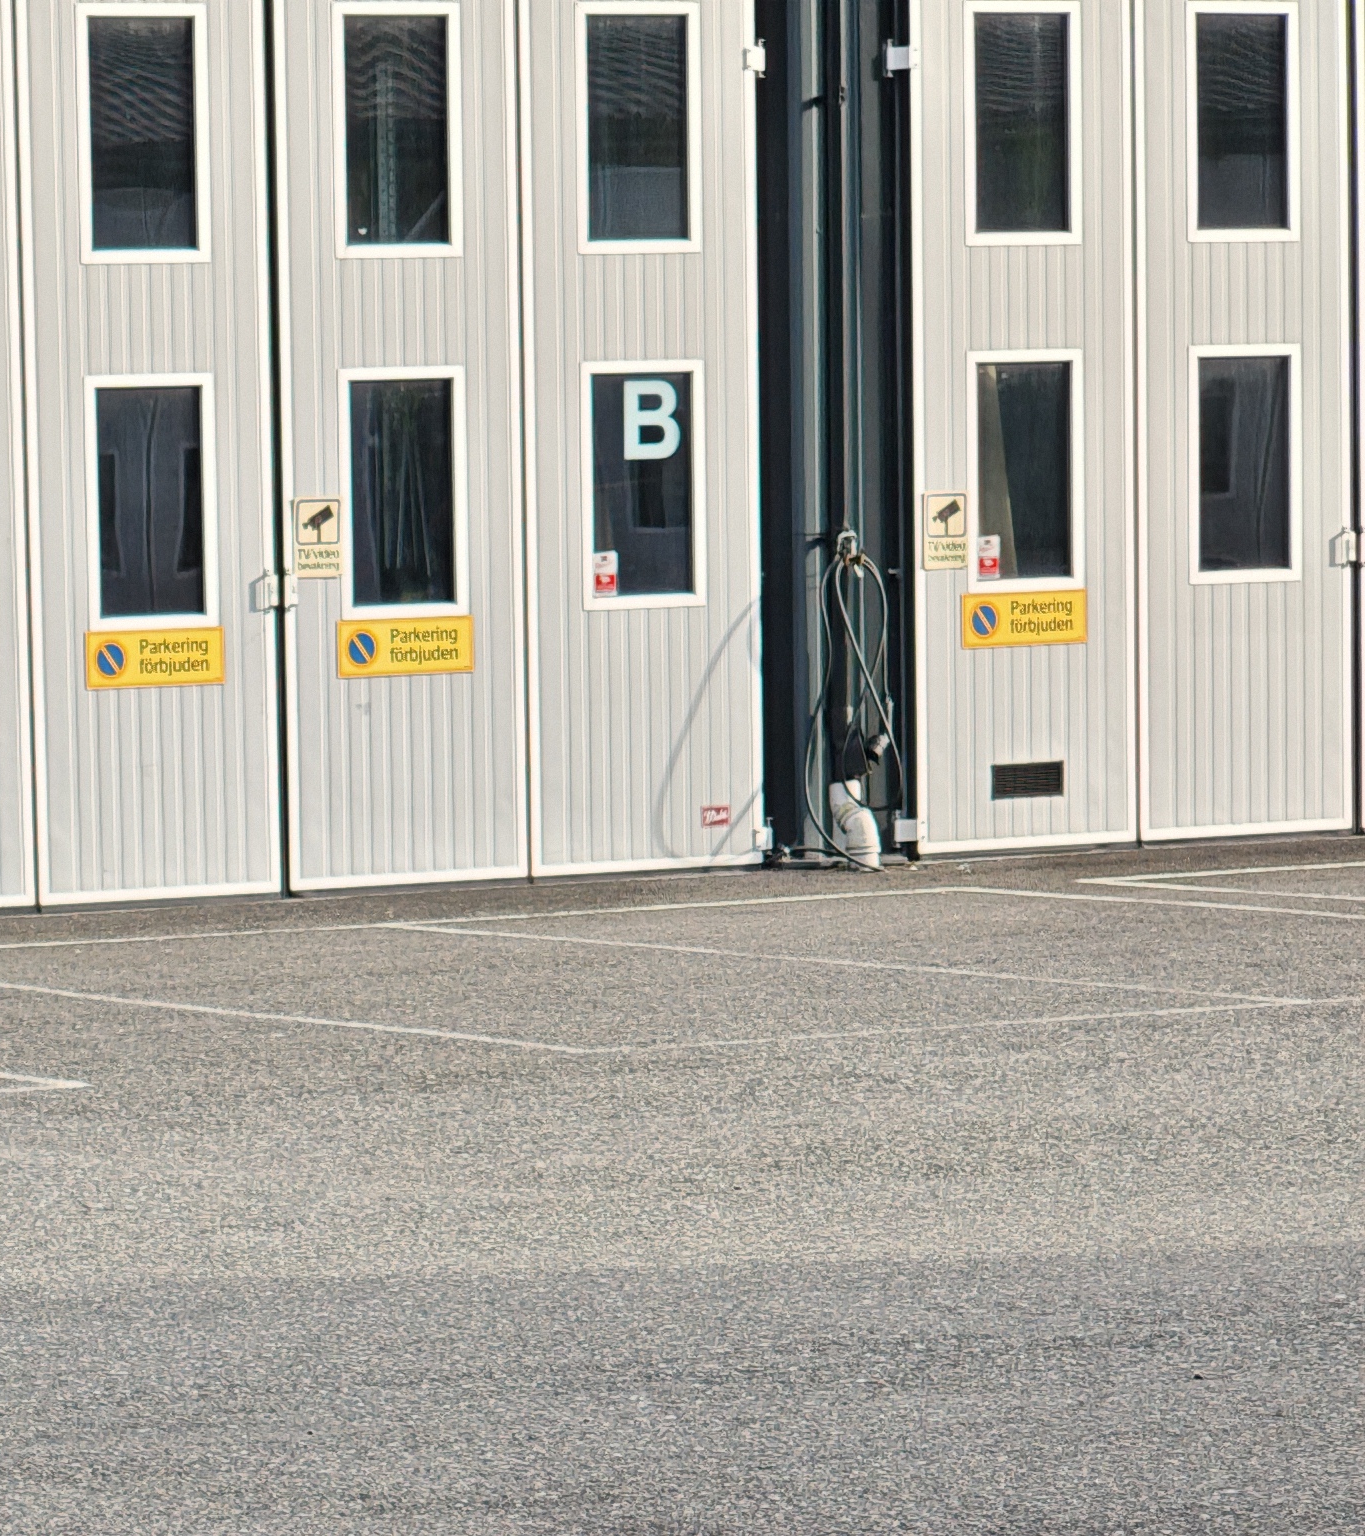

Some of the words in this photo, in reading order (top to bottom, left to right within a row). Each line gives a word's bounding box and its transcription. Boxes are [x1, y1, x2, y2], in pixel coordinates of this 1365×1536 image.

[623, 379, 681, 460] B
[1010, 597, 1073, 616] Parkering
[390, 625, 458, 644] Parkering
[1009, 617, 1074, 636] förbjuden
[139, 637, 209, 656] Parkering
[389, 645, 459, 665] förbjuden
[139, 657, 210, 676] förbjuden
